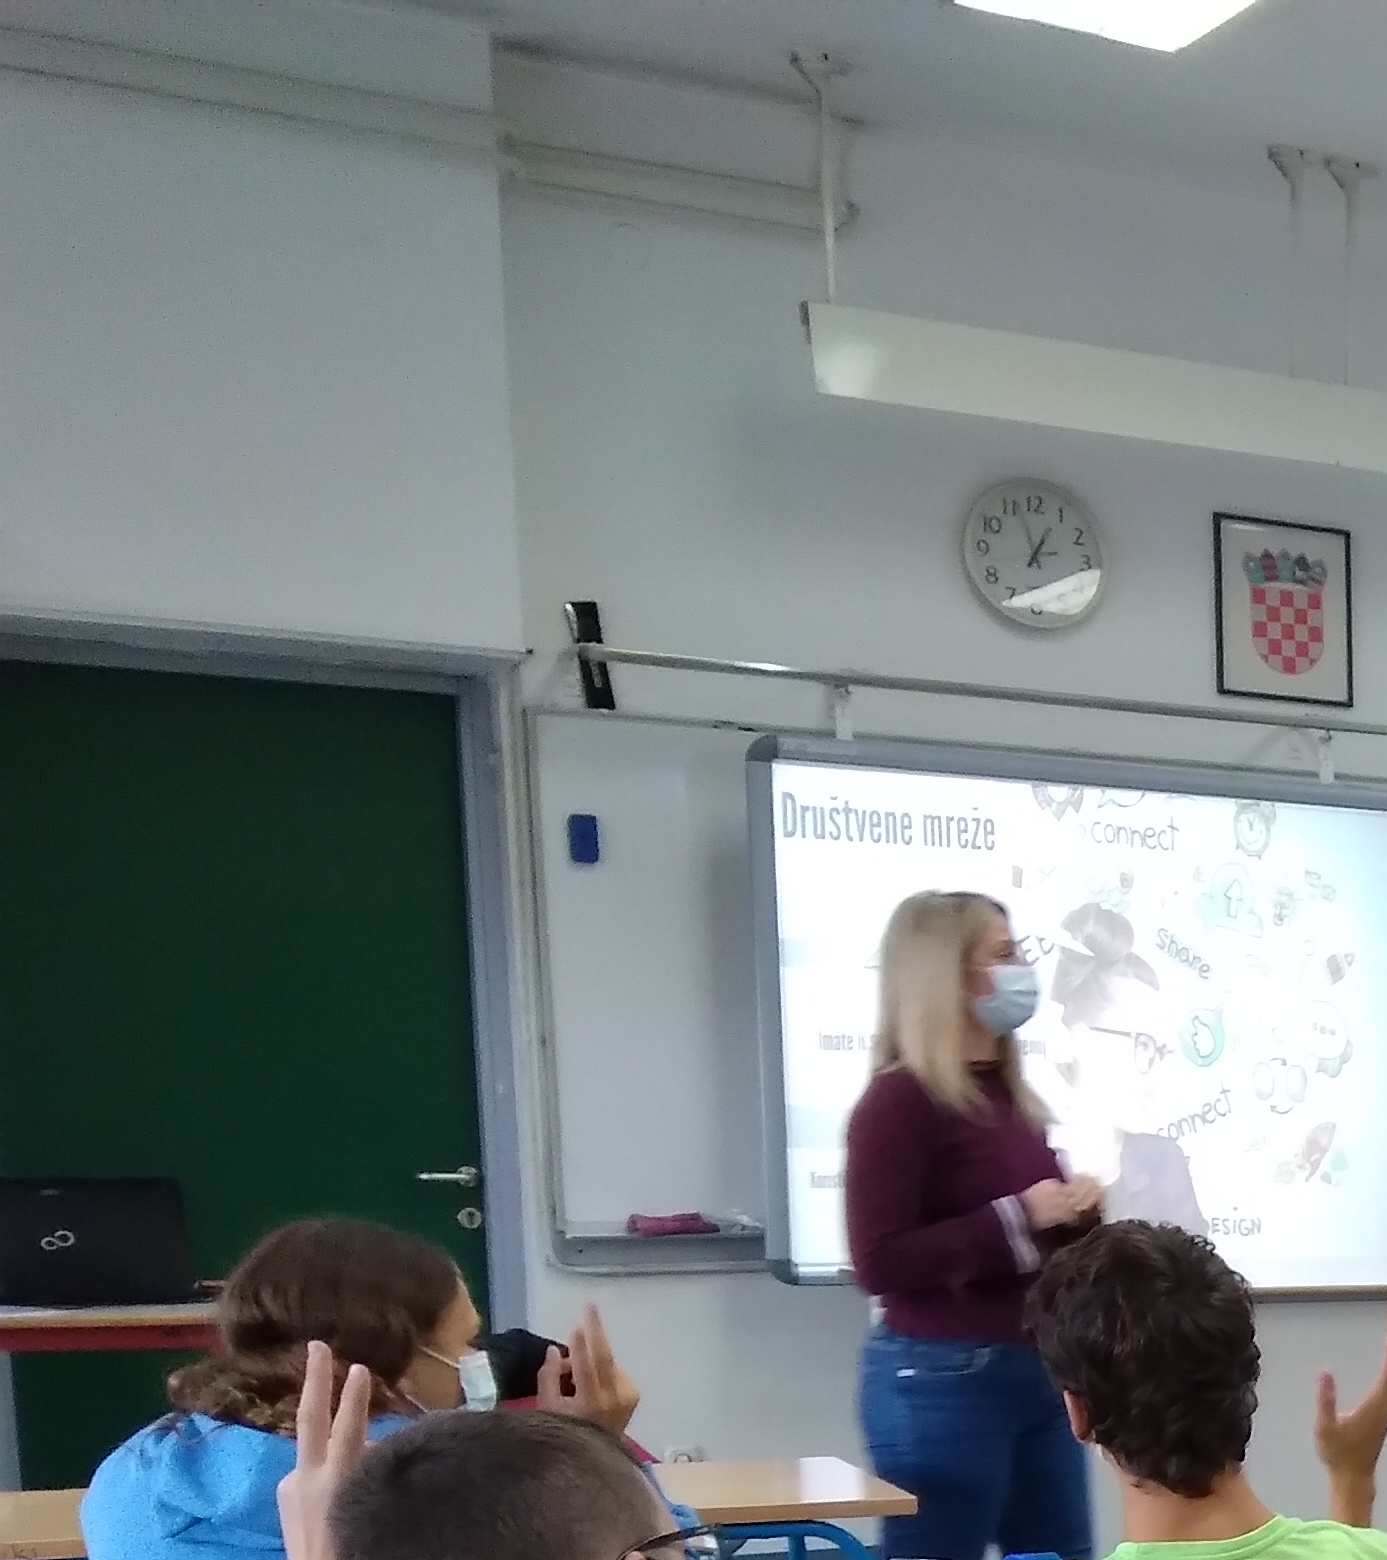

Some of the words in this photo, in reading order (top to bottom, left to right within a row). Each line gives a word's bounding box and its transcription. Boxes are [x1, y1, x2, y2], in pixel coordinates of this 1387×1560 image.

[1003, 498, 1017, 516] 11
[1026, 495, 1044, 515] 12
[982, 515, 1002, 534] 10
[1073, 527, 1084, 546] 2
[976, 539, 990, 556] 9
[1080, 554, 1092, 571] 3
[985, 565, 998, 584] 8
[781, 791, 913, 846] Društvene
[922, 806, 996, 851] mreže
[1091, 815, 1180, 852] connect
